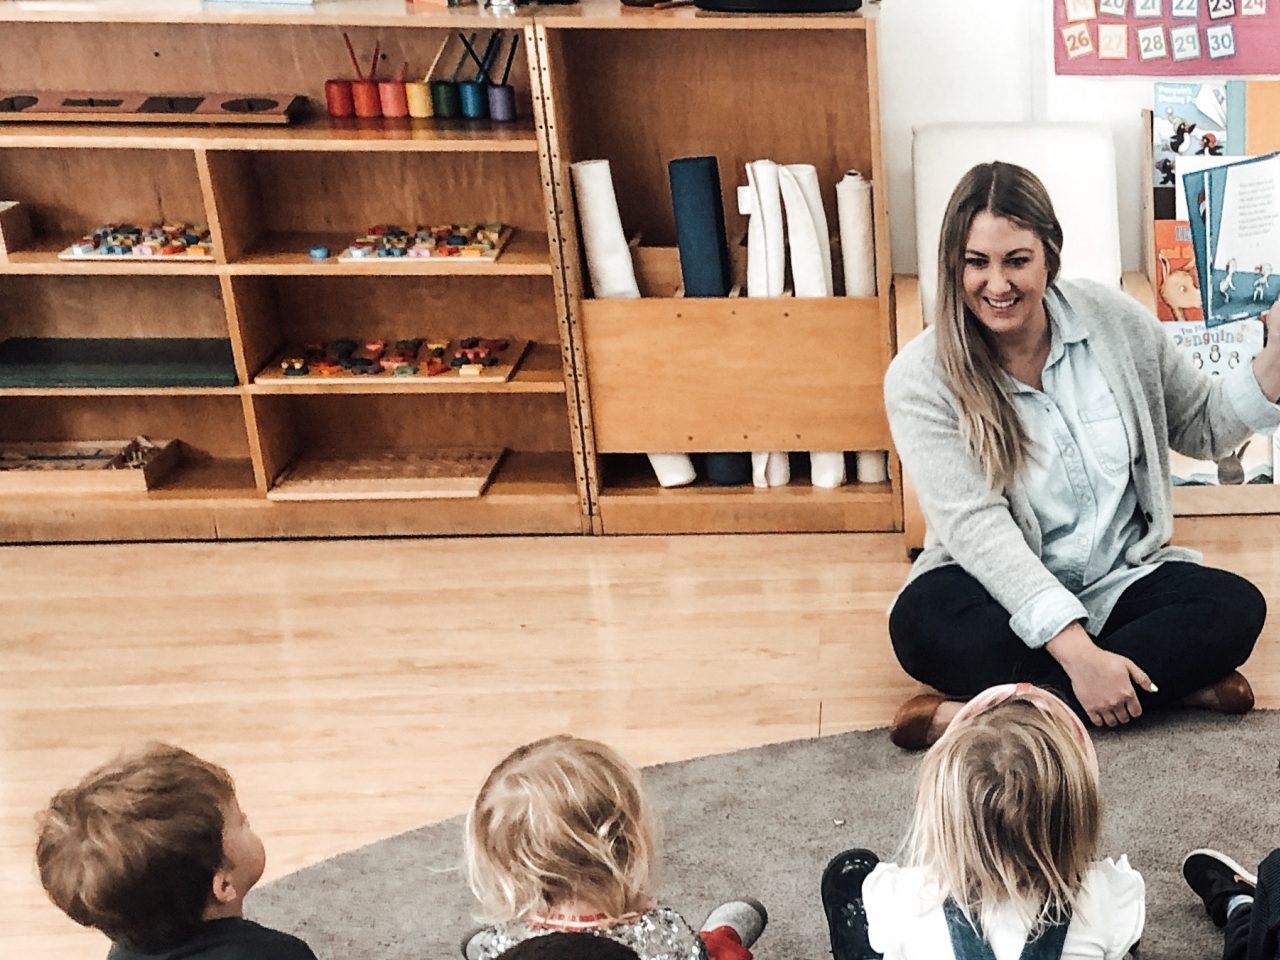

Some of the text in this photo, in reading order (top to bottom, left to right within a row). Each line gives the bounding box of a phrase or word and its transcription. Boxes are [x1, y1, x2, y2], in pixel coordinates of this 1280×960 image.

[1066, 31, 1089, 51] 26
[1142, 35, 1163, 52] 28
[1175, 34, 1197, 53] 29
[1210, 33, 1232, 51] 30
